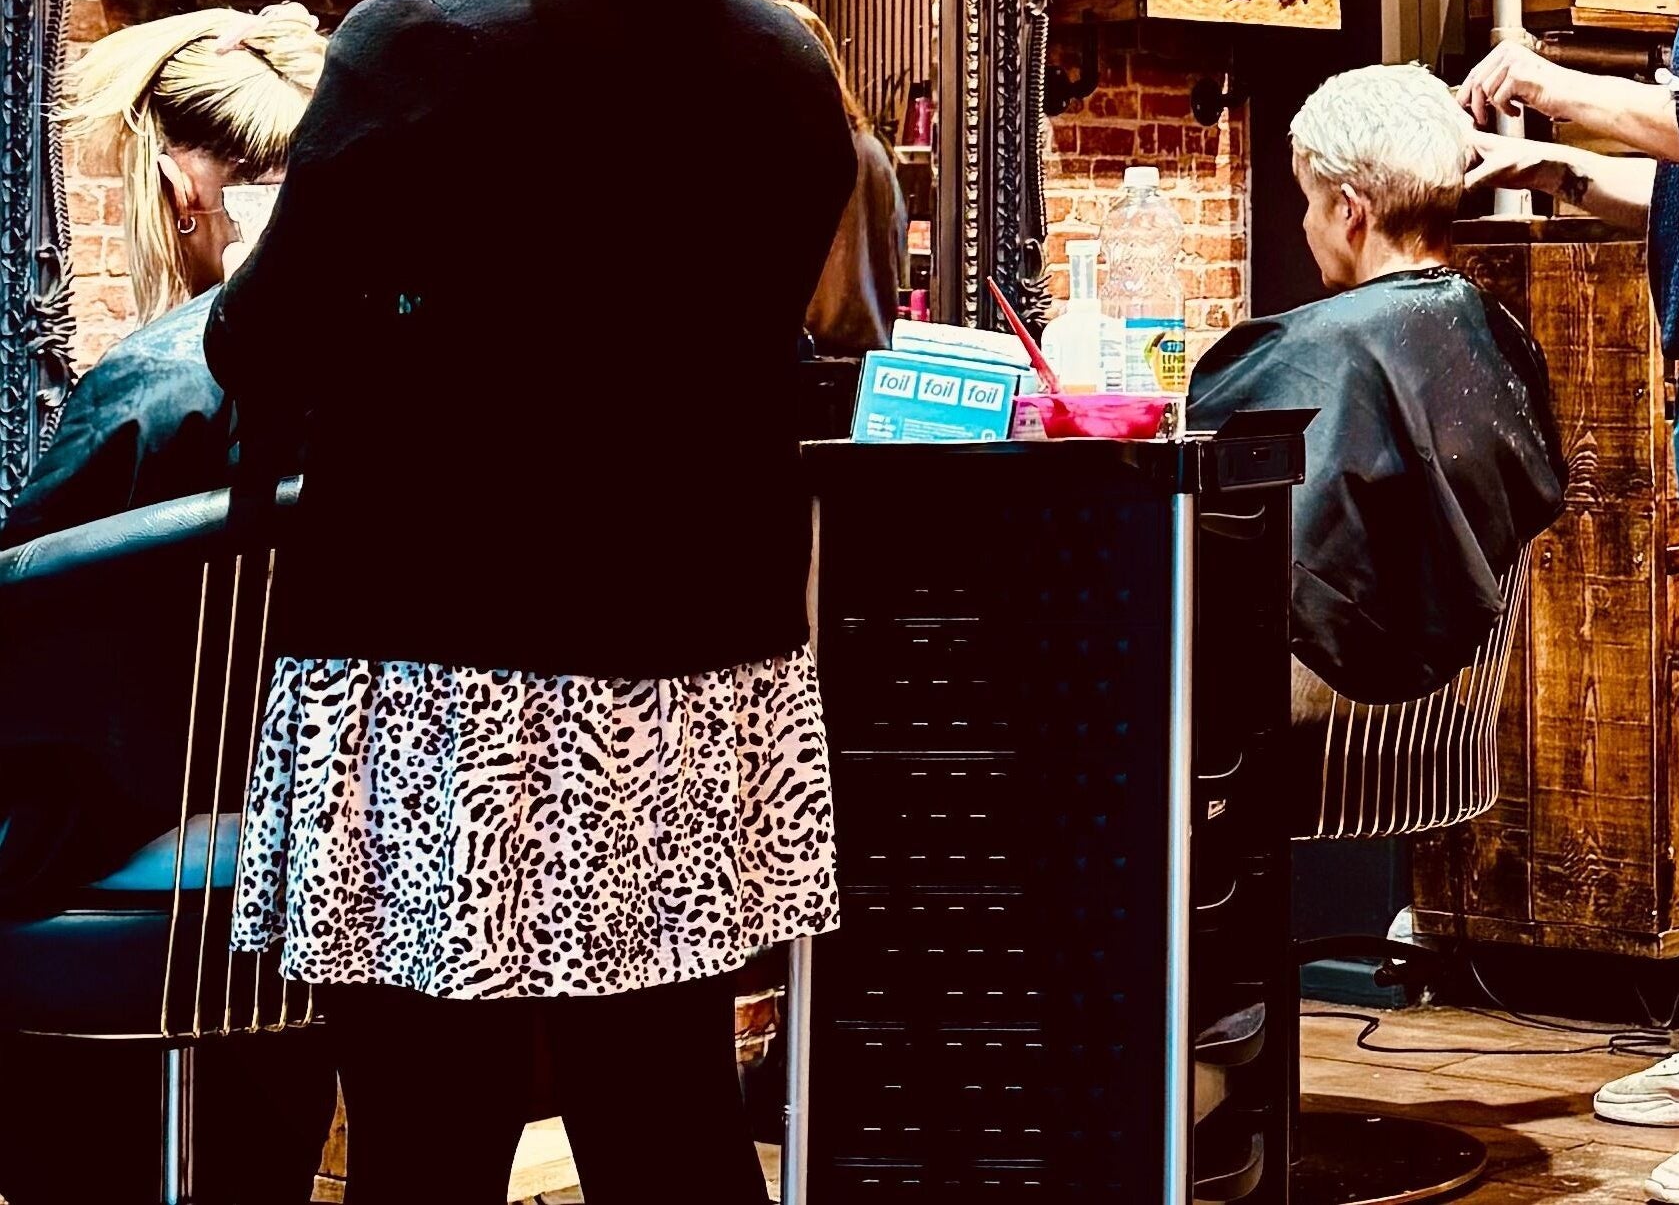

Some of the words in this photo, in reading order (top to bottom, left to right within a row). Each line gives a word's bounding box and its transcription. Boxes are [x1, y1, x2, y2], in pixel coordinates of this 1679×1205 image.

[880, 372, 911, 391] foil
[924, 378, 955, 398] foil
[967, 384, 999, 404] foil
